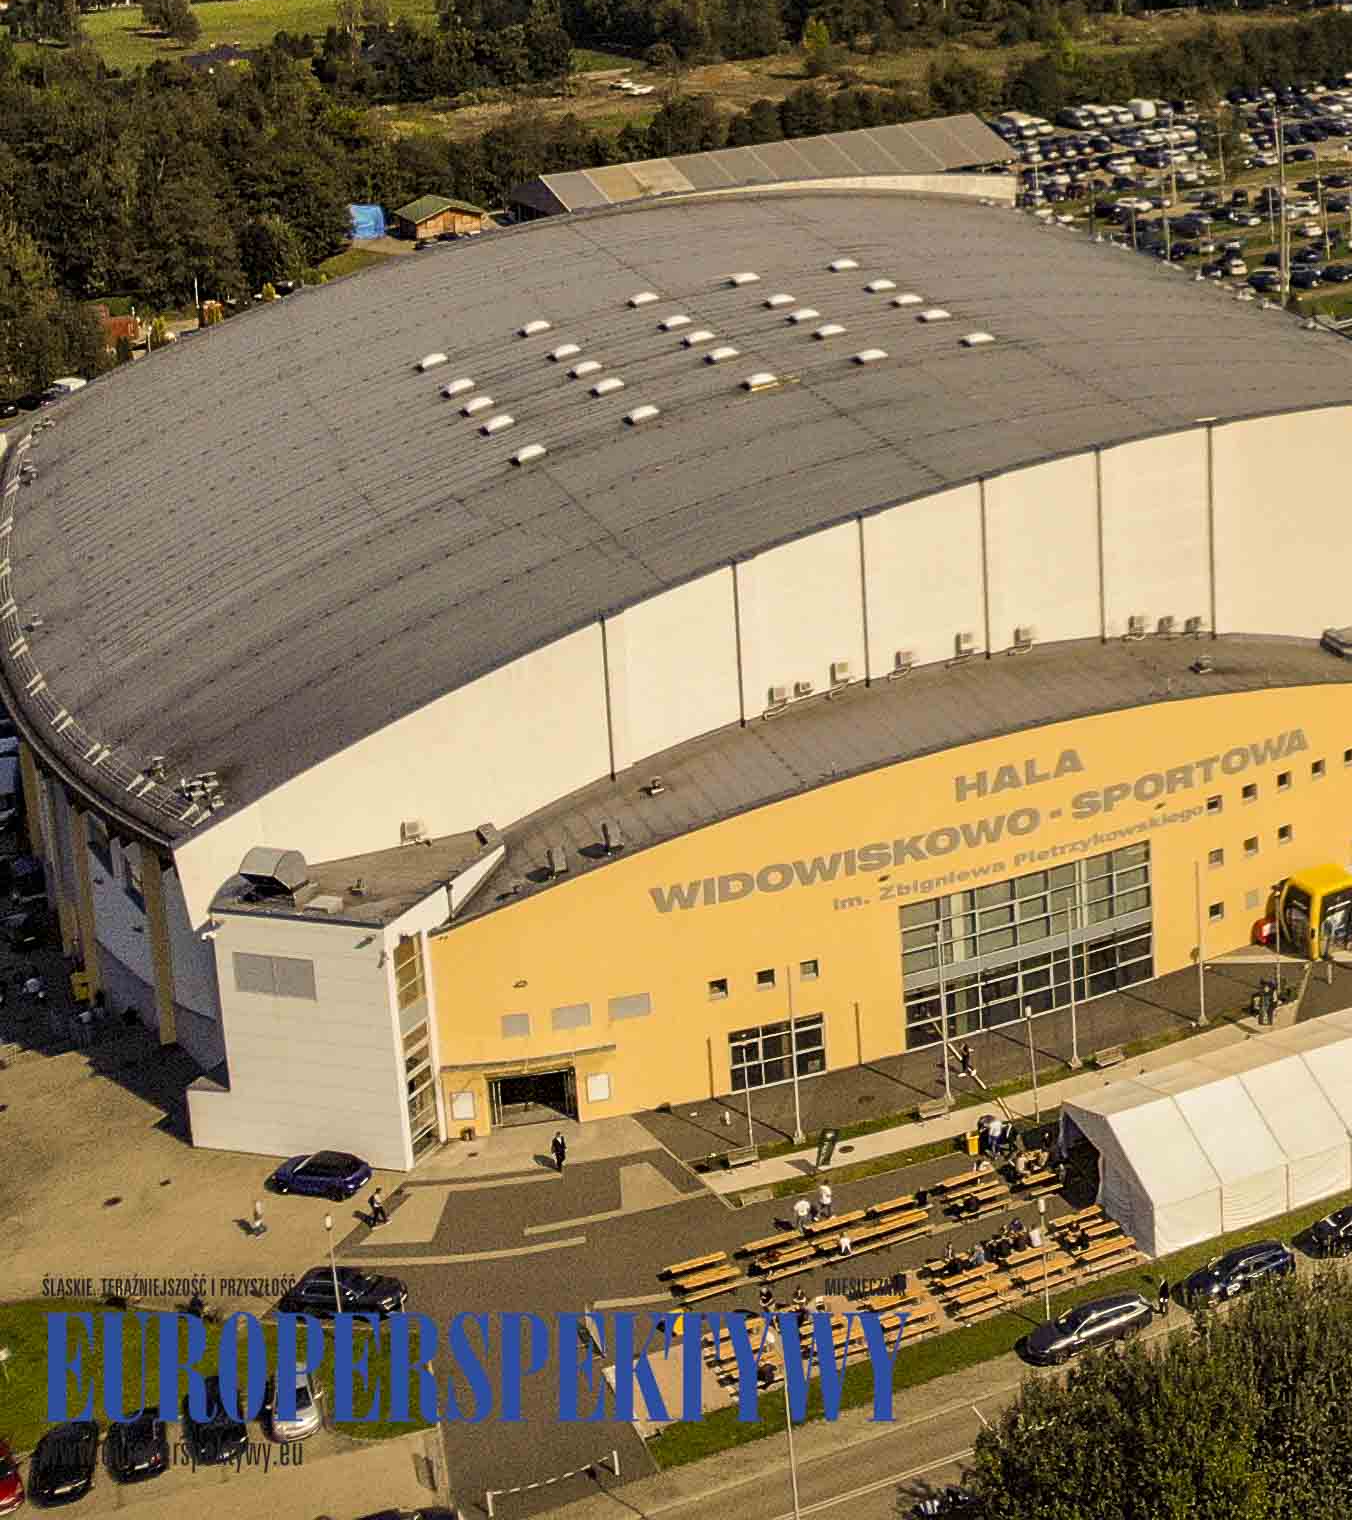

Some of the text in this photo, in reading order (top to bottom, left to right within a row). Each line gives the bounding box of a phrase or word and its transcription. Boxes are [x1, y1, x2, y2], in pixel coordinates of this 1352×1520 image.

[649, 806, 1040, 914] WIDOWISKOWO
[1071, 727, 1310, 821] SPORTOWA
[955, 748, 1085, 802] HALA
[833, 804, 1205, 912] im. Zbigniewa Pietrzykowskiego
